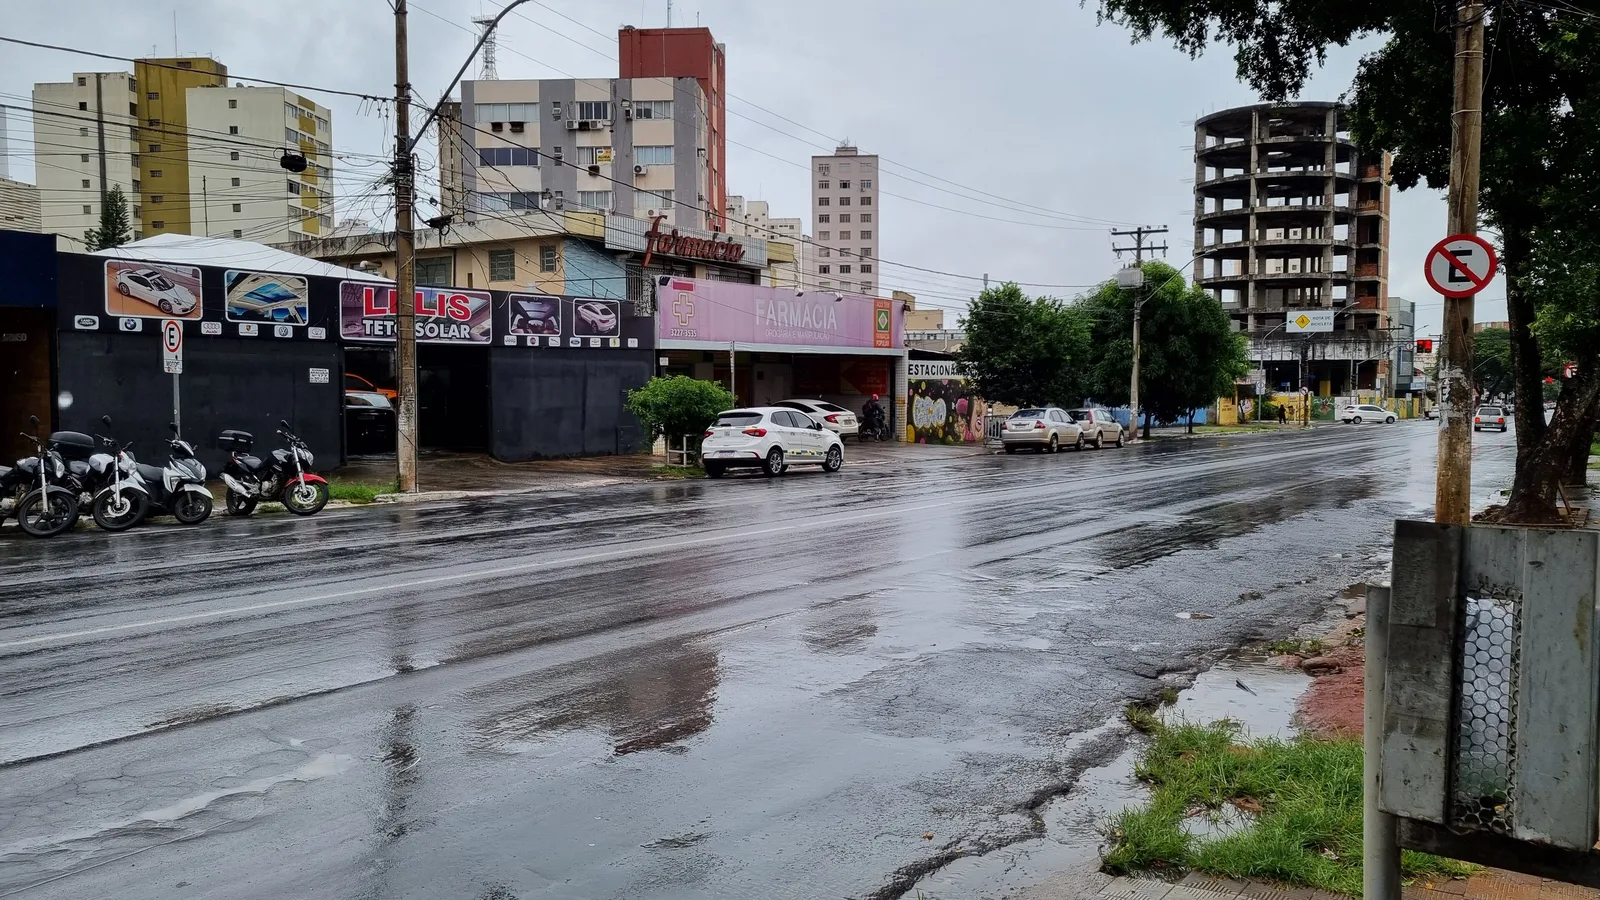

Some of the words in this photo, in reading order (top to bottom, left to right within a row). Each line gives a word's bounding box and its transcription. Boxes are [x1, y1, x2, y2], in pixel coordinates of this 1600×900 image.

[1448, 249, 1473, 282] E
[169, 327, 175, 346] E
[362, 319, 397, 335] TET
[415, 322, 470, 339] SOLAR
